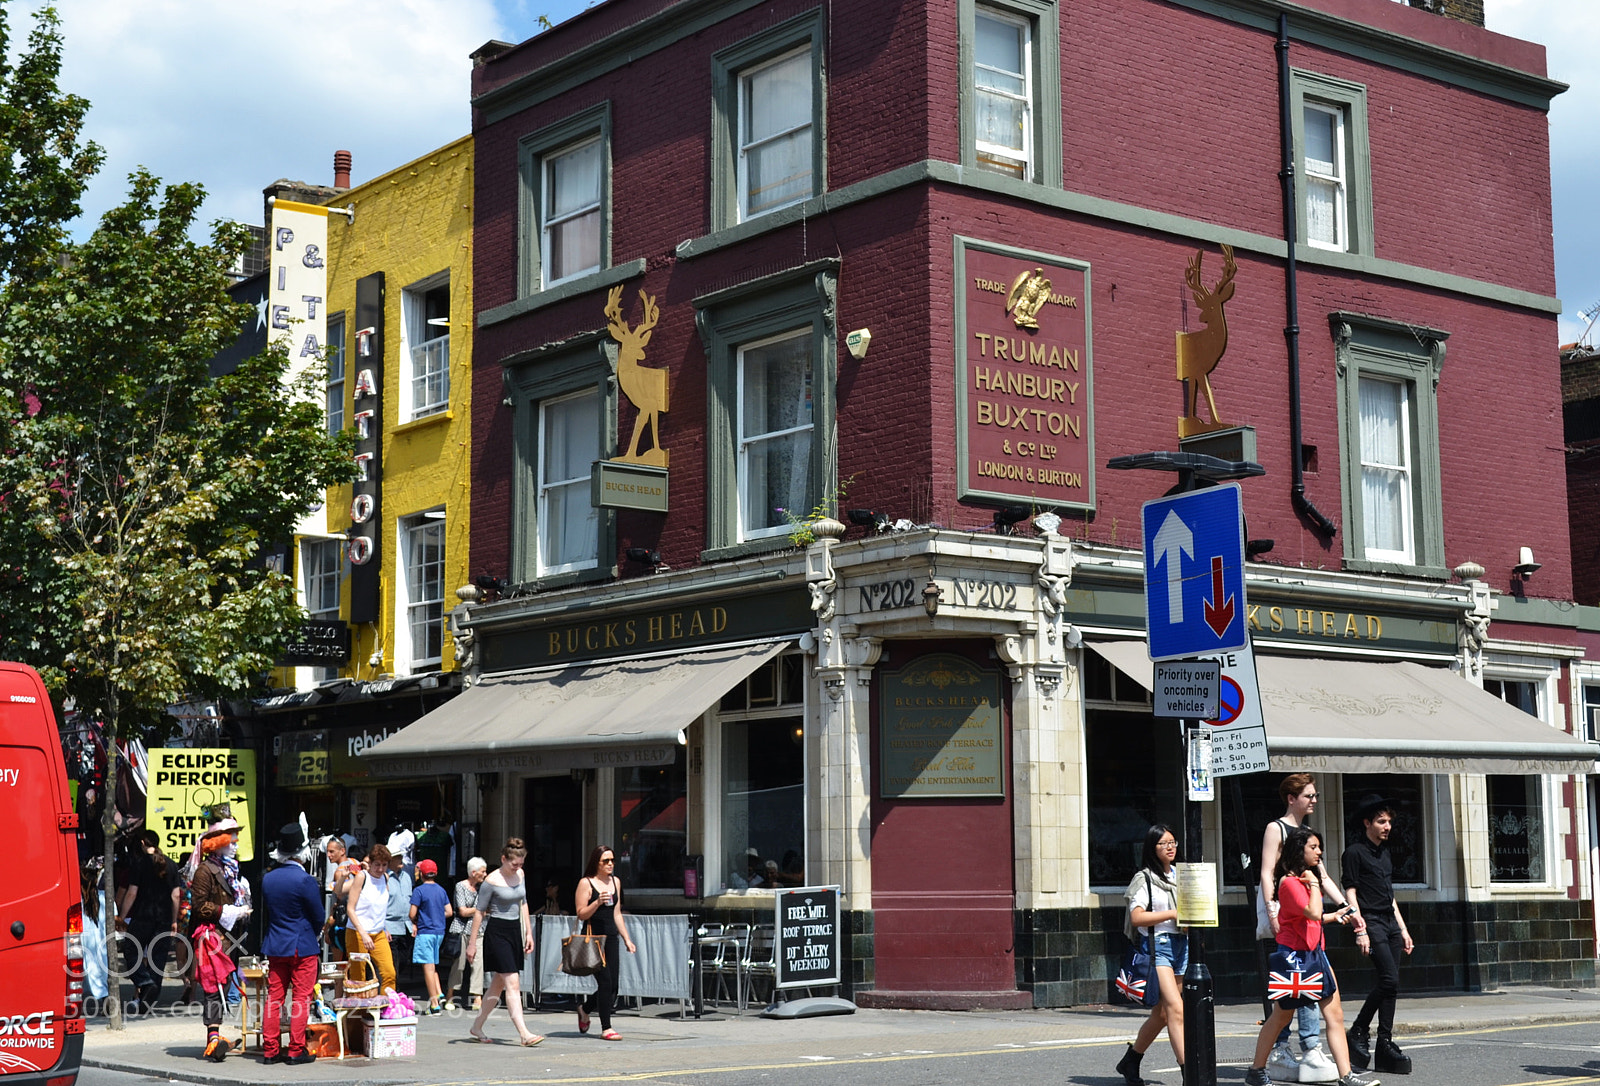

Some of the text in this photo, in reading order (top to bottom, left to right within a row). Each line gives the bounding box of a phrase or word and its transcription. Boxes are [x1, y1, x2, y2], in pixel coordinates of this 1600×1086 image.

[302, 244, 323, 269] &
[975, 277, 1006, 294] TRADE
[1047, 293, 1077, 308] MARK
[975, 332, 1079, 372] TRUMAN
[975, 366, 1080, 404] HANBURY
[977, 400, 1080, 439] BUXTON
[1003, 439, 1012, 455] &
[977, 460, 1081, 488] LONDON & BURTON
[605, 481, 662, 496] BUCKS HEAD
[547, 606, 727, 656] BUCKS HEAD
[1294, 608, 1383, 641] HEAD
[1158, 668, 1215, 683] Priority over
[1164, 685, 1209, 698] oncoming
[895, 695, 990, 707] BUCKS HEAD
[1167, 700, 1205, 712] vehicles
[927, 739, 952, 748] ROOF
[952, 738, 994, 748] TERRACE
[1211, 735, 1224, 743] on
[1230, 733, 1242, 741] Fri
[1228, 741, 1248, 751] 6.30
[1250, 741, 1263, 750] pm
[162, 754, 238, 769] ECLIPSE
[477, 755, 542, 769] BUCKS HEAD
[593, 749, 666, 763] BUCKS HEAD
[1229, 753, 1246, 762] Sun
[1290, 756, 1327, 768] HEAD
[1231, 762, 1251, 771] 5.30
[1253, 762, 1266, 771] pm
[1385, 758, 1466, 769] BUCKS HEAD
[1517, 760, 1590, 770] BUCKS HEAD
[156, 771, 245, 786] PIERCING
[890, 777, 996, 785] EVENING ENTERTAINMENT
[1494, 847, 1529, 855] REAL ALES
[787, 906, 807, 920] FREE
[783, 924, 832, 938] ROOF TERRACE
[804, 944, 829, 958] EVERY
[789, 958, 830, 972] WEEKEND
[0, 1038, 55, 1049] ORLDWIDE
